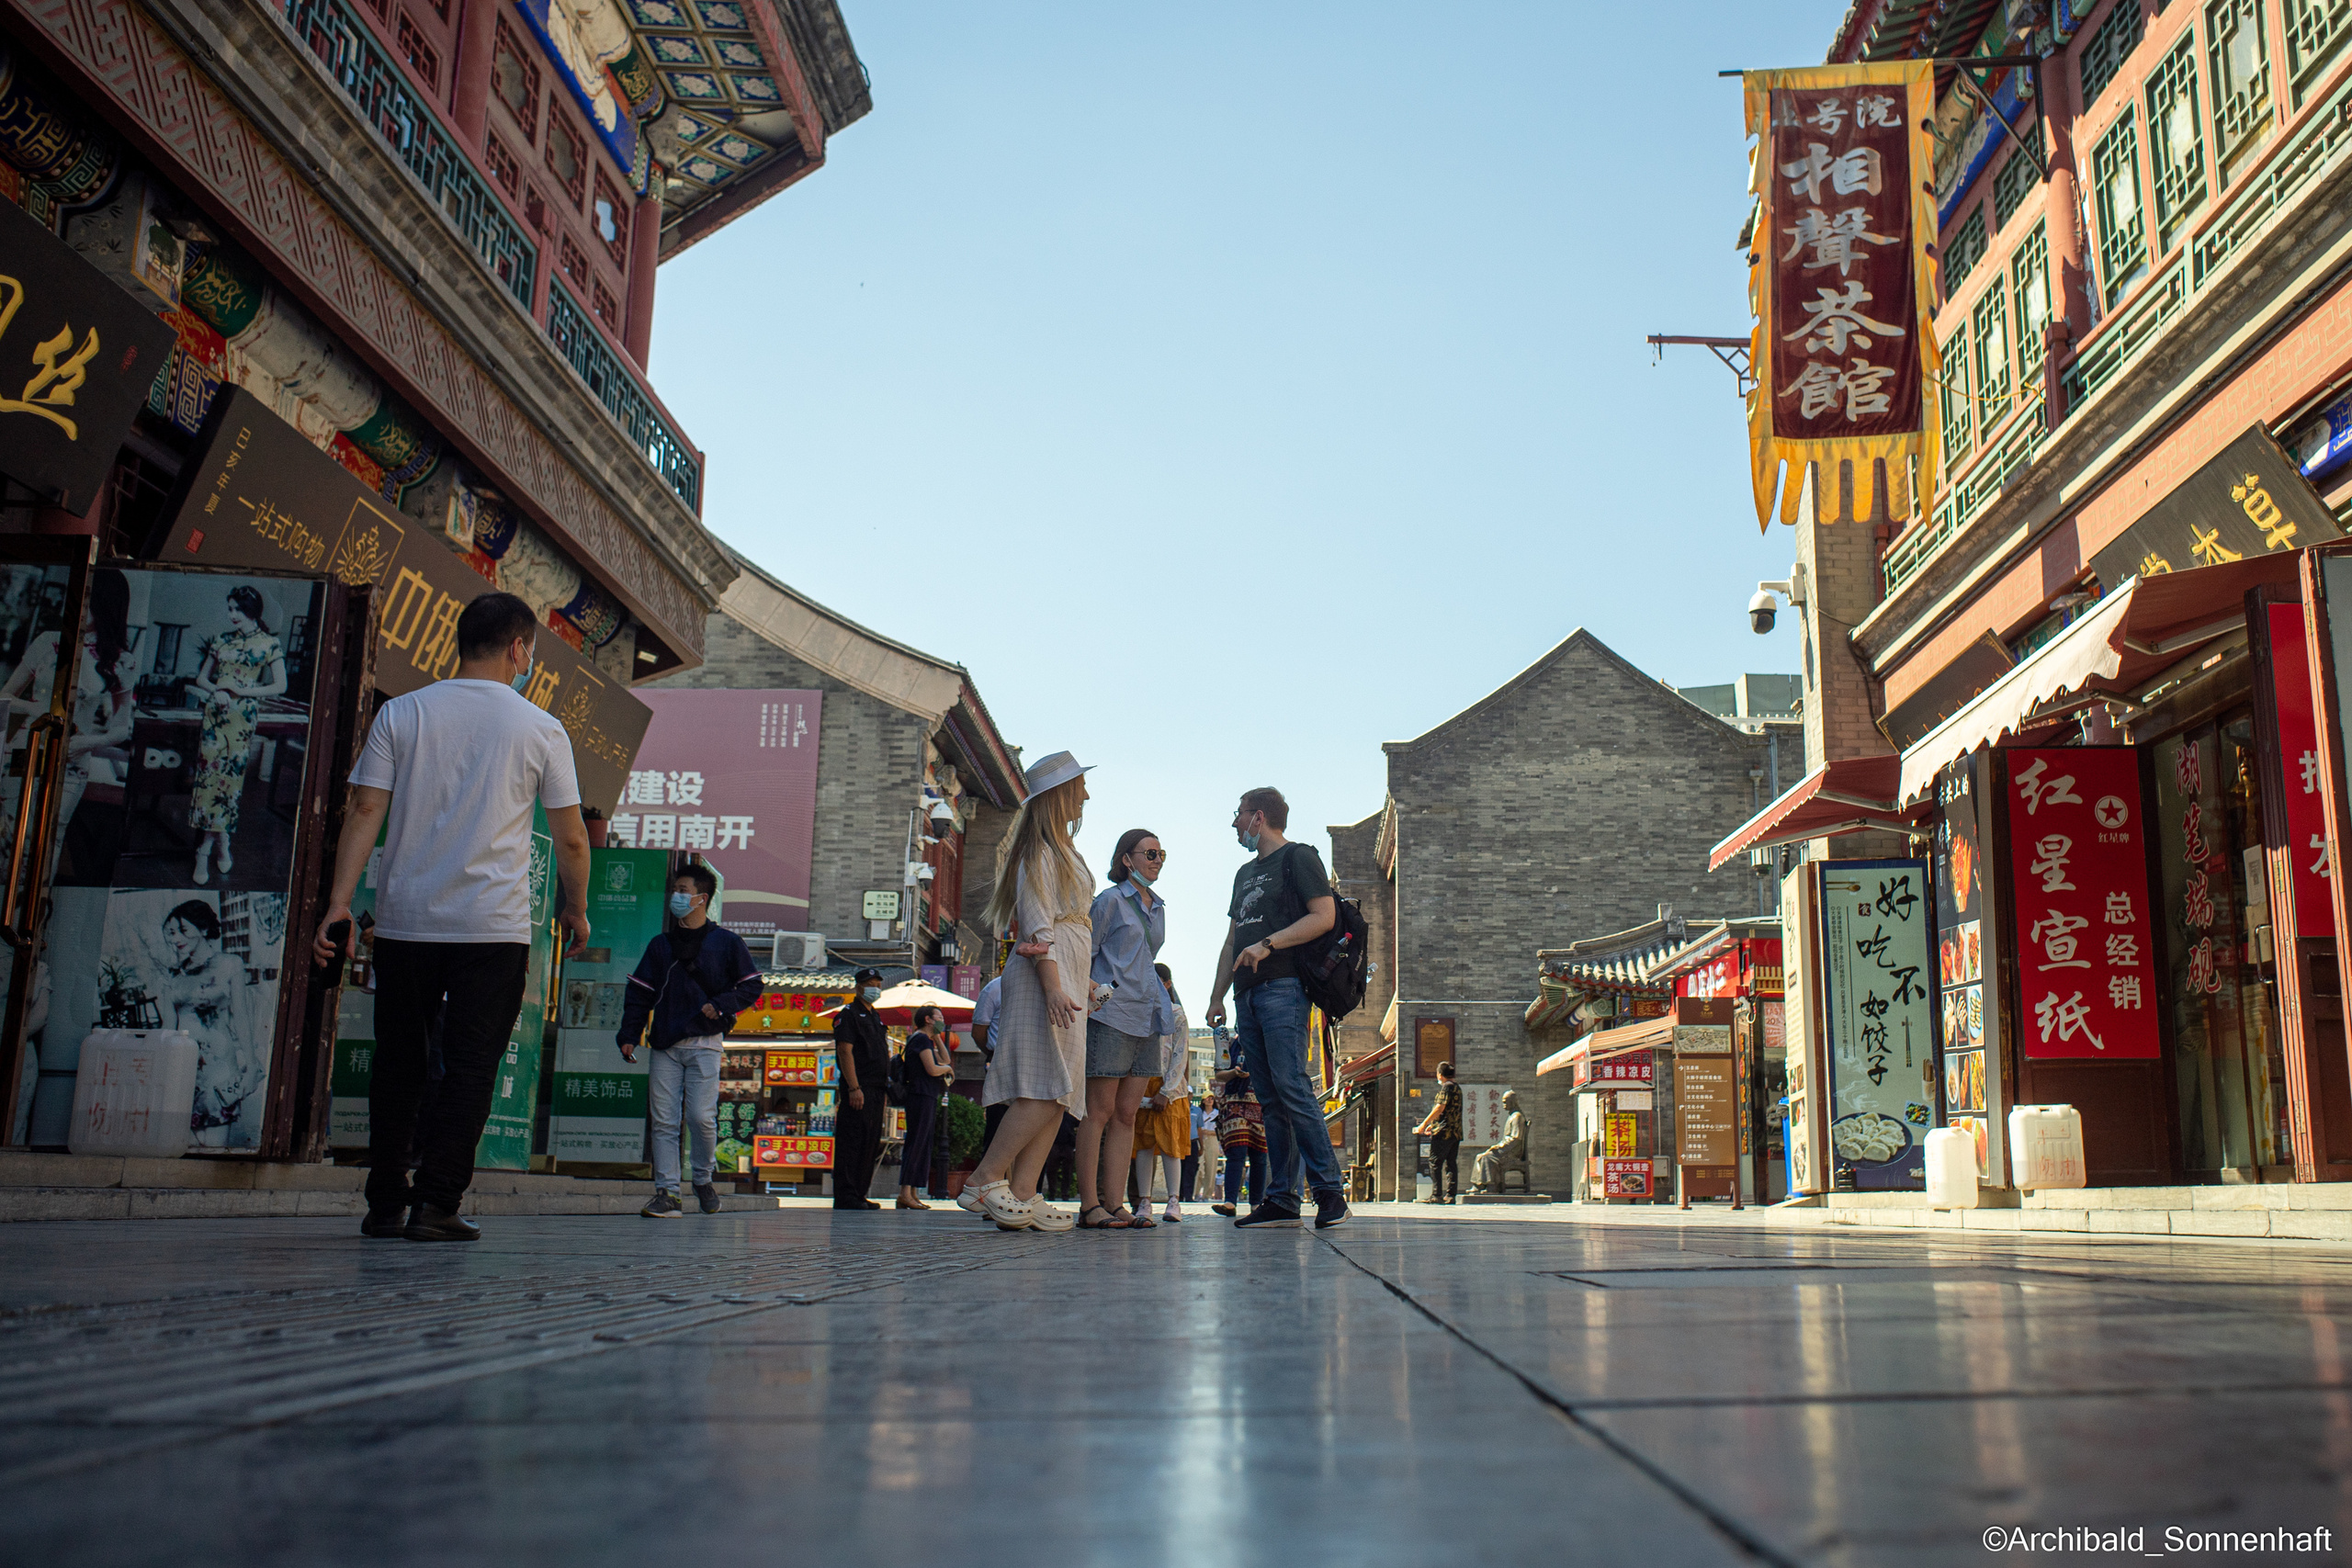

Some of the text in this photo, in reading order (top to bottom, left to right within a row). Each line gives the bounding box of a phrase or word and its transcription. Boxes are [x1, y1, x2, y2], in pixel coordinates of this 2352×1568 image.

[1771, 95, 1902, 135] 号院
[1779, 142, 1905, 423] 相聲茶館
[238, 494, 325, 570] 一站式购物
[617, 770, 705, 807] 建设
[1939, 773, 1969, 807] 舌尖上的
[606, 813, 755, 851] 信用南开
[2098, 832, 2130, 843] 红星牌
[2176, 740, 2222, 994] 湖笔端砚
[2015, 758, 2105, 1050] 红星宣纸
[2104, 891, 2143, 1010] 总经销
[564, 1078, 634, 1099] 精美饰品
[1603, 1066, 1651, 1078] 香辣凉皮
[1607, 1172, 1620, 1194] 茶汤
